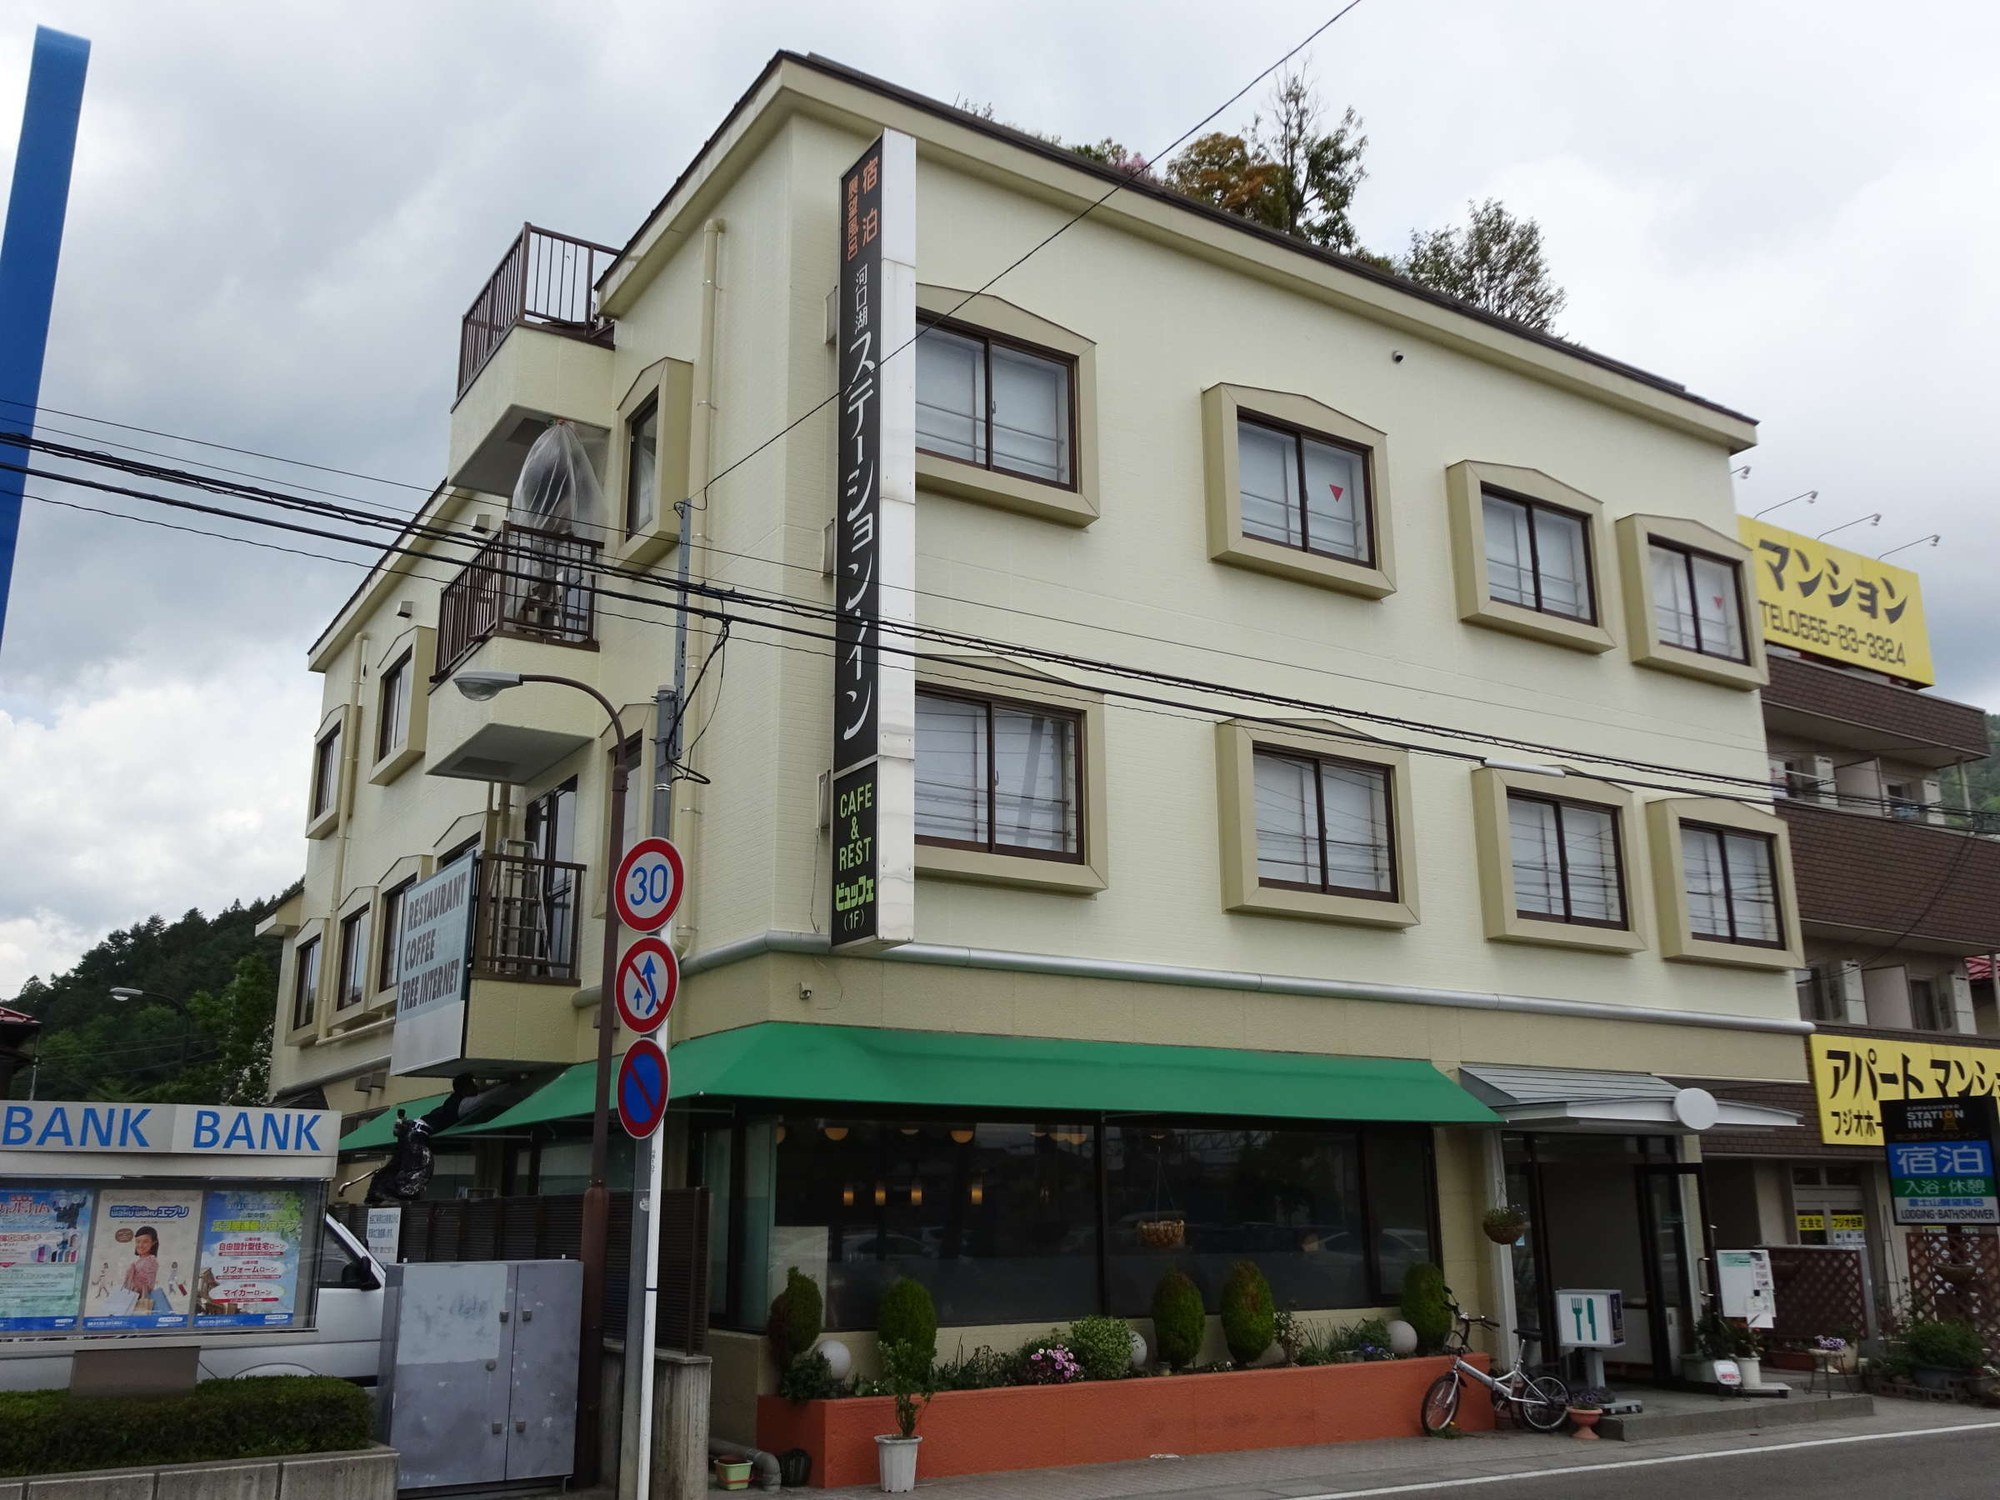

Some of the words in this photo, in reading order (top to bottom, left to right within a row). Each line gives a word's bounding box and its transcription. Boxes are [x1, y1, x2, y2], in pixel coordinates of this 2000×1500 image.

[847, 174, 859, 262] 展望風呂
[862, 155, 878, 247] 宿泊
[855, 263, 869, 335] 河口湖
[843, 330, 876, 741] ステーションイン
[1759, 538, 1909, 625] マンション
[839, 782, 873, 819] CAFE
[850, 815, 860, 841] &
[839, 836, 872, 872] REST
[408, 871, 467, 932] RESTAURANT
[629, 863, 669, 906] 30
[836, 875, 874, 912] ビュッフェ
[843, 908, 865, 933] (1F)
[404, 927, 437, 972] COFFEE
[400, 974, 419, 1012] FREE
[418, 958, 460, 1006] INTERNET
[1826, 1048, 2000, 1100] アパートマンシ
[1, 1105, 153, 1148] BANK
[192, 1109, 323, 1152] BANK
[1906, 1109, 1965, 1121] STATION
[1907, 1119, 1934, 1129] INN
[1896, 1144, 1985, 1175] 宿泊
[222, 1265, 277, 1274] リフォームローン
[223, 1288, 272, 1297] マイカーローン
